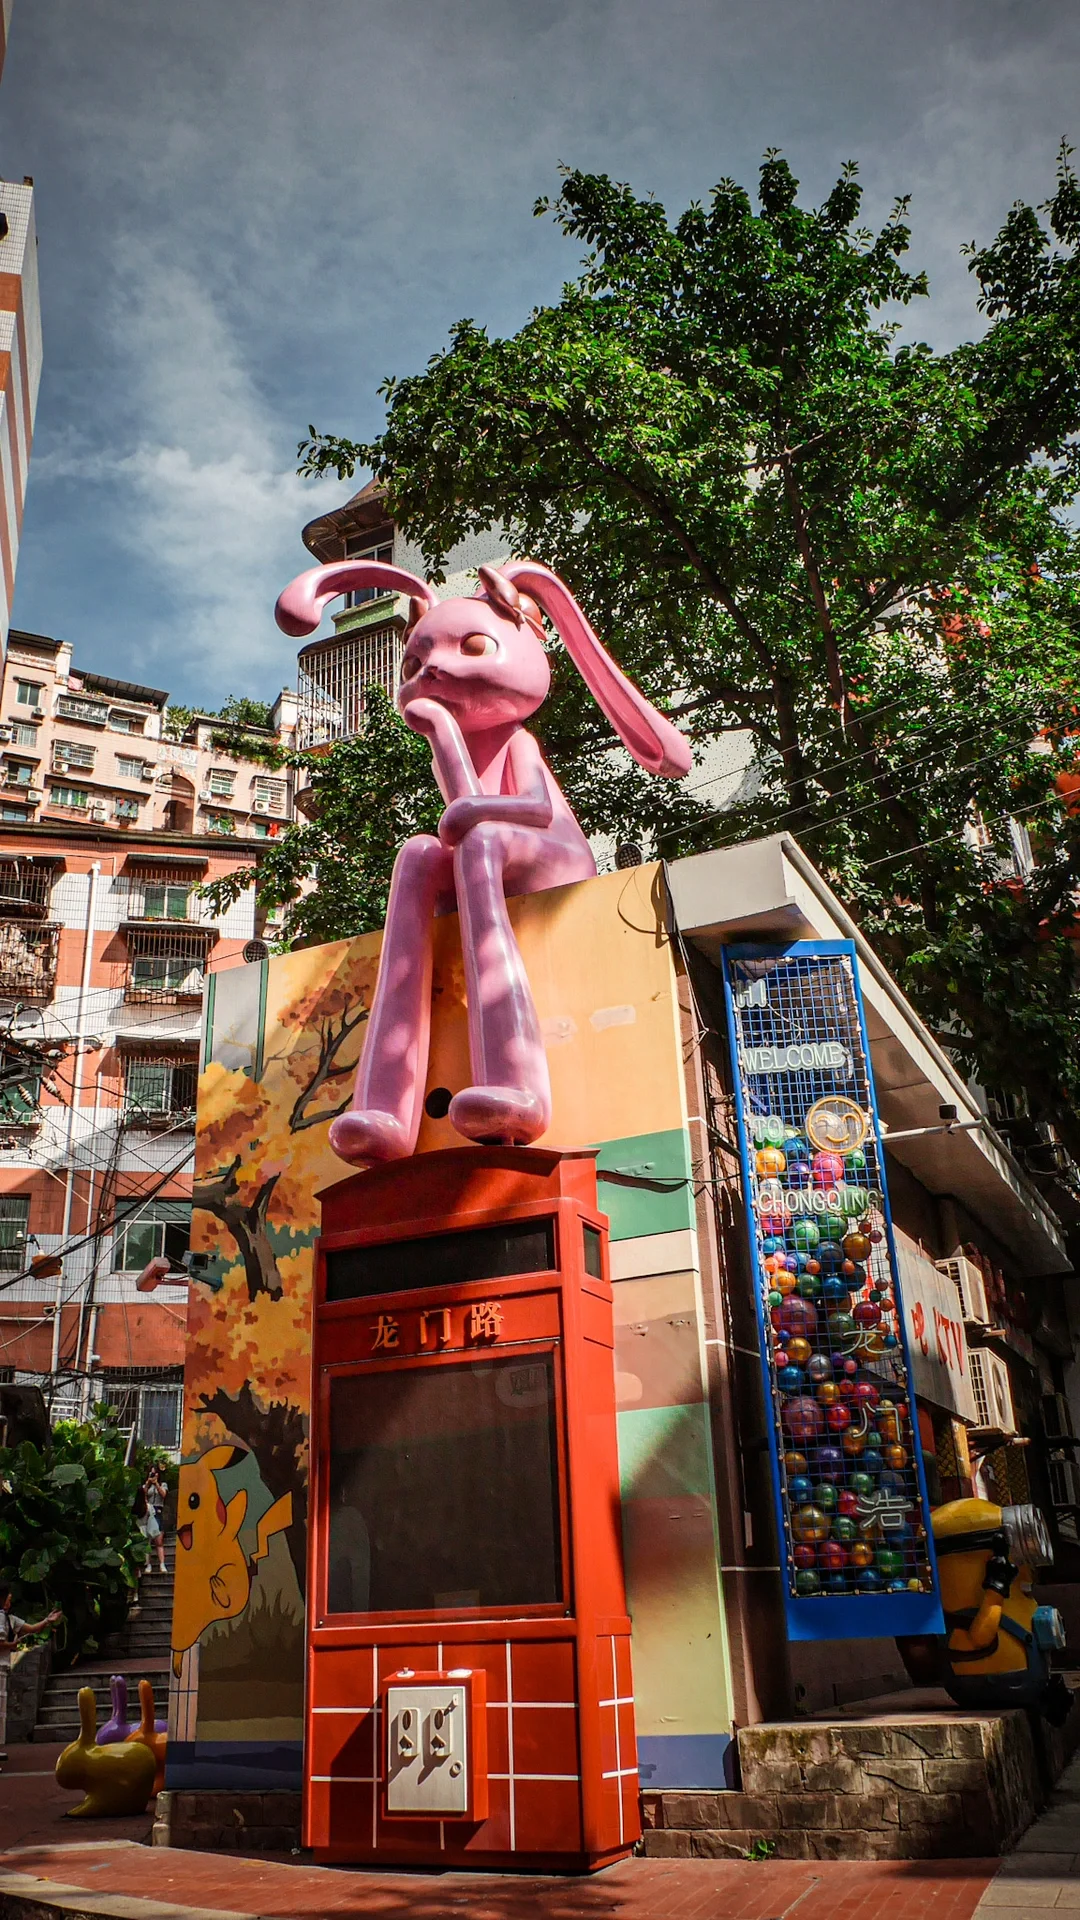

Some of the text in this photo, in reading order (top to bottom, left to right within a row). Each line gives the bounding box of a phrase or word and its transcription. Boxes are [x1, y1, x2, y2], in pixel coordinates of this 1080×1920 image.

[743, 1042, 845, 1074] WELCOME
[752, 1115, 785, 1142] TO
[758, 1189, 881, 1214] CHONGQING
[369, 1301, 505, 1351] 龙门路
[932, 1306, 964, 1376] KTV
[840, 1321, 914, 1528] 龙门浩
